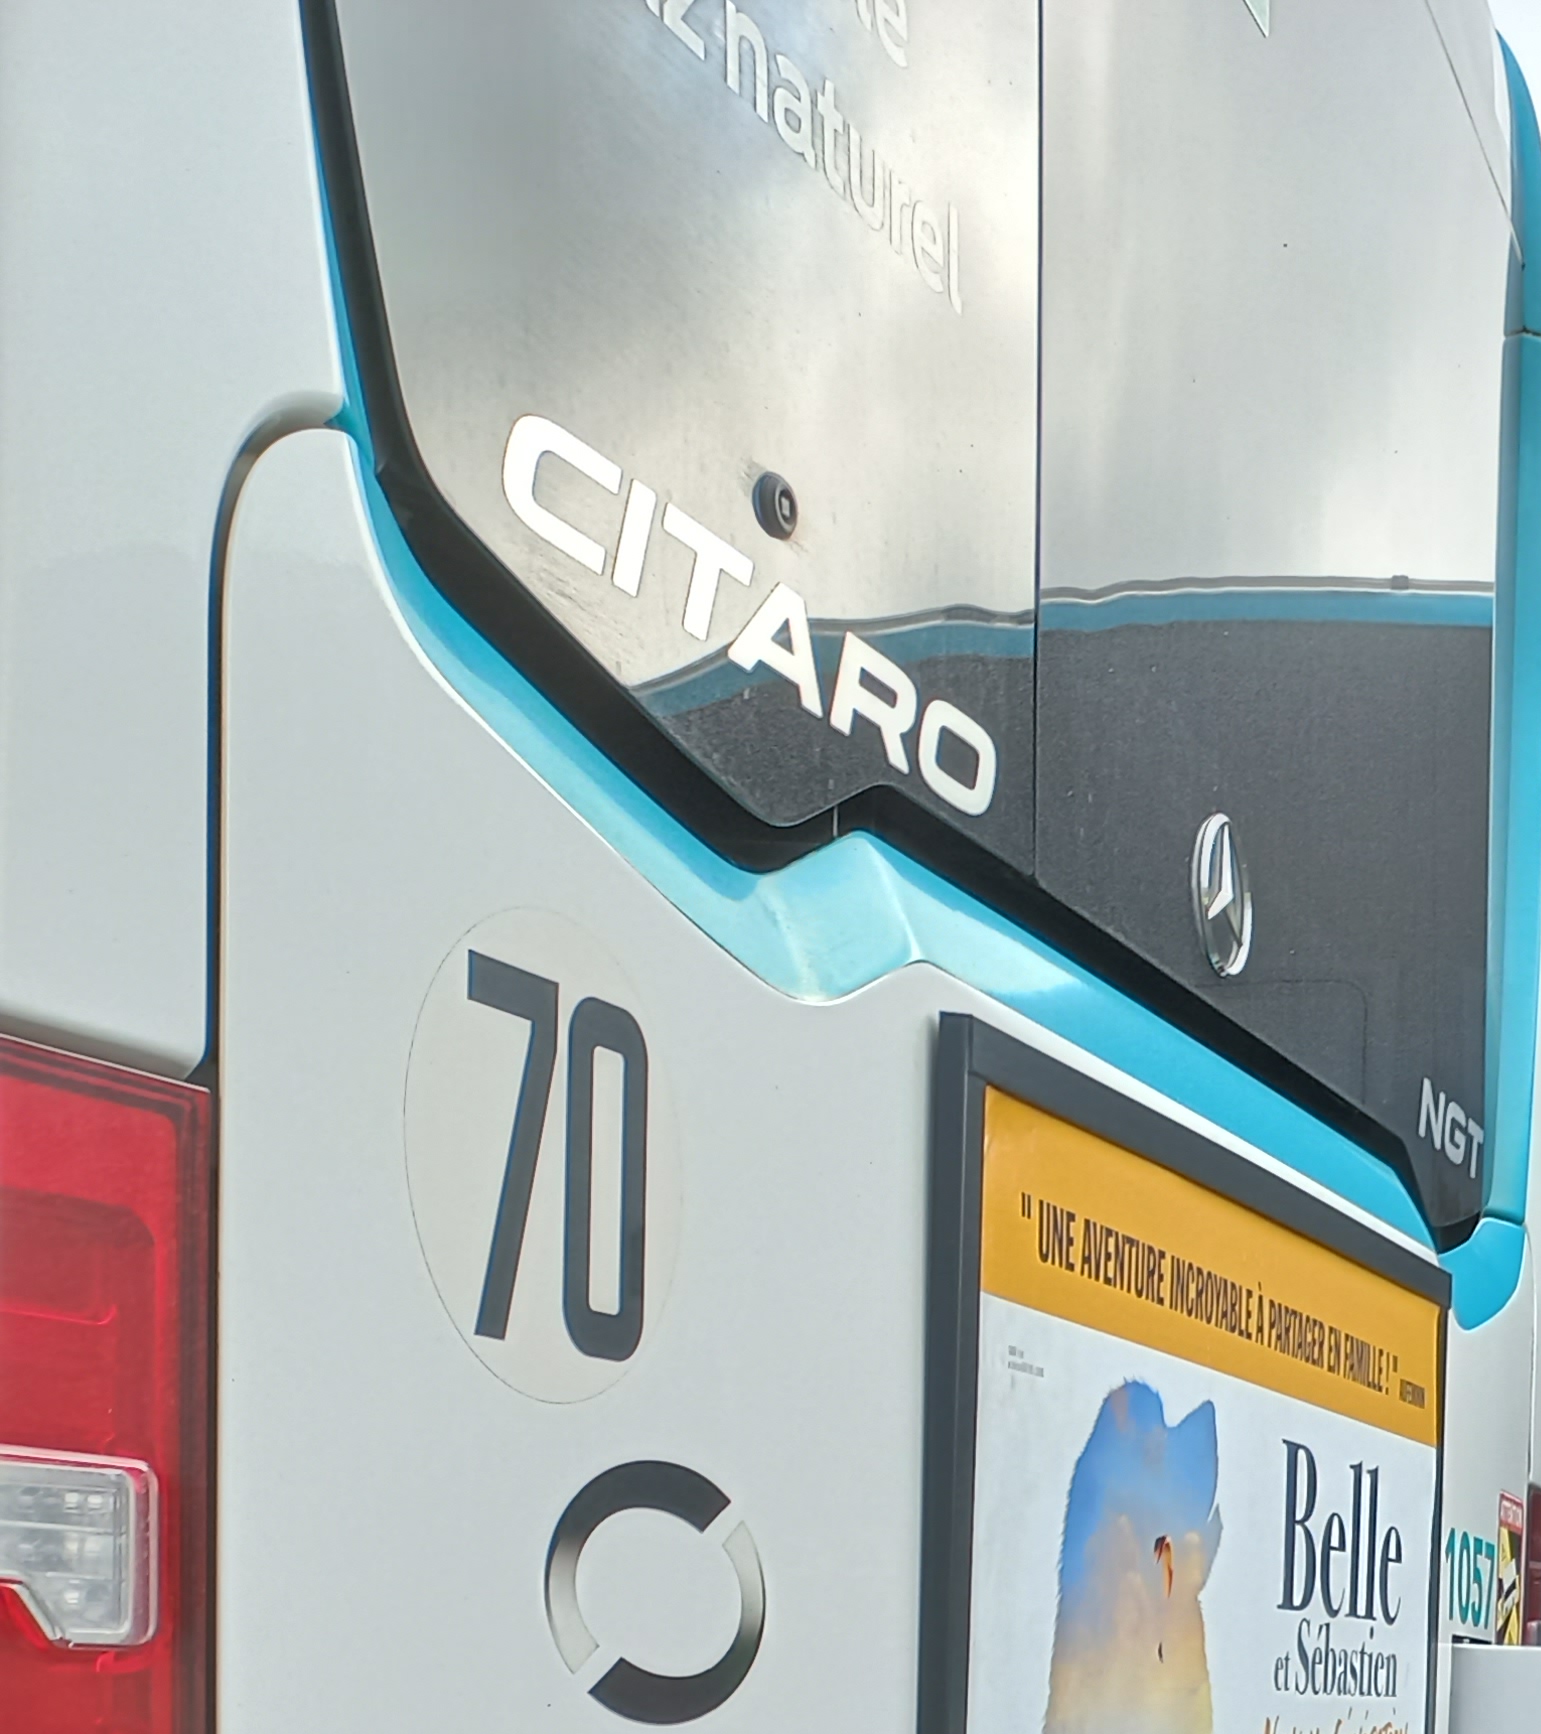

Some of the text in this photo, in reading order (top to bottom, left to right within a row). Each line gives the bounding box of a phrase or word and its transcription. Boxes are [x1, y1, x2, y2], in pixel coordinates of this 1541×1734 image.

[724, 0, 963, 316] naturel
[502, 412, 998, 818] CITARO
[466, 948, 650, 1363] 70
[1418, 1077, 1484, 1179] NGT
[1037, 1200, 1077, 1273] UNE
[1080, 1218, 1167, 1307] AVENTURE
[1169, 1254, 1253, 1344] INCROYABLE
[1254, 1281, 1265, 1346] À
[1268, 1299, 1325, 1369] PARTAGER
[1327, 1325, 1342, 1376] EN
[1343, 1334, 1384, 1392] FAMILLE
[1276, 1438, 1402, 1627] Belle
[1445, 1527, 1495, 1631] 1057
[1273, 1616, 1398, 1699] et Sébastien
